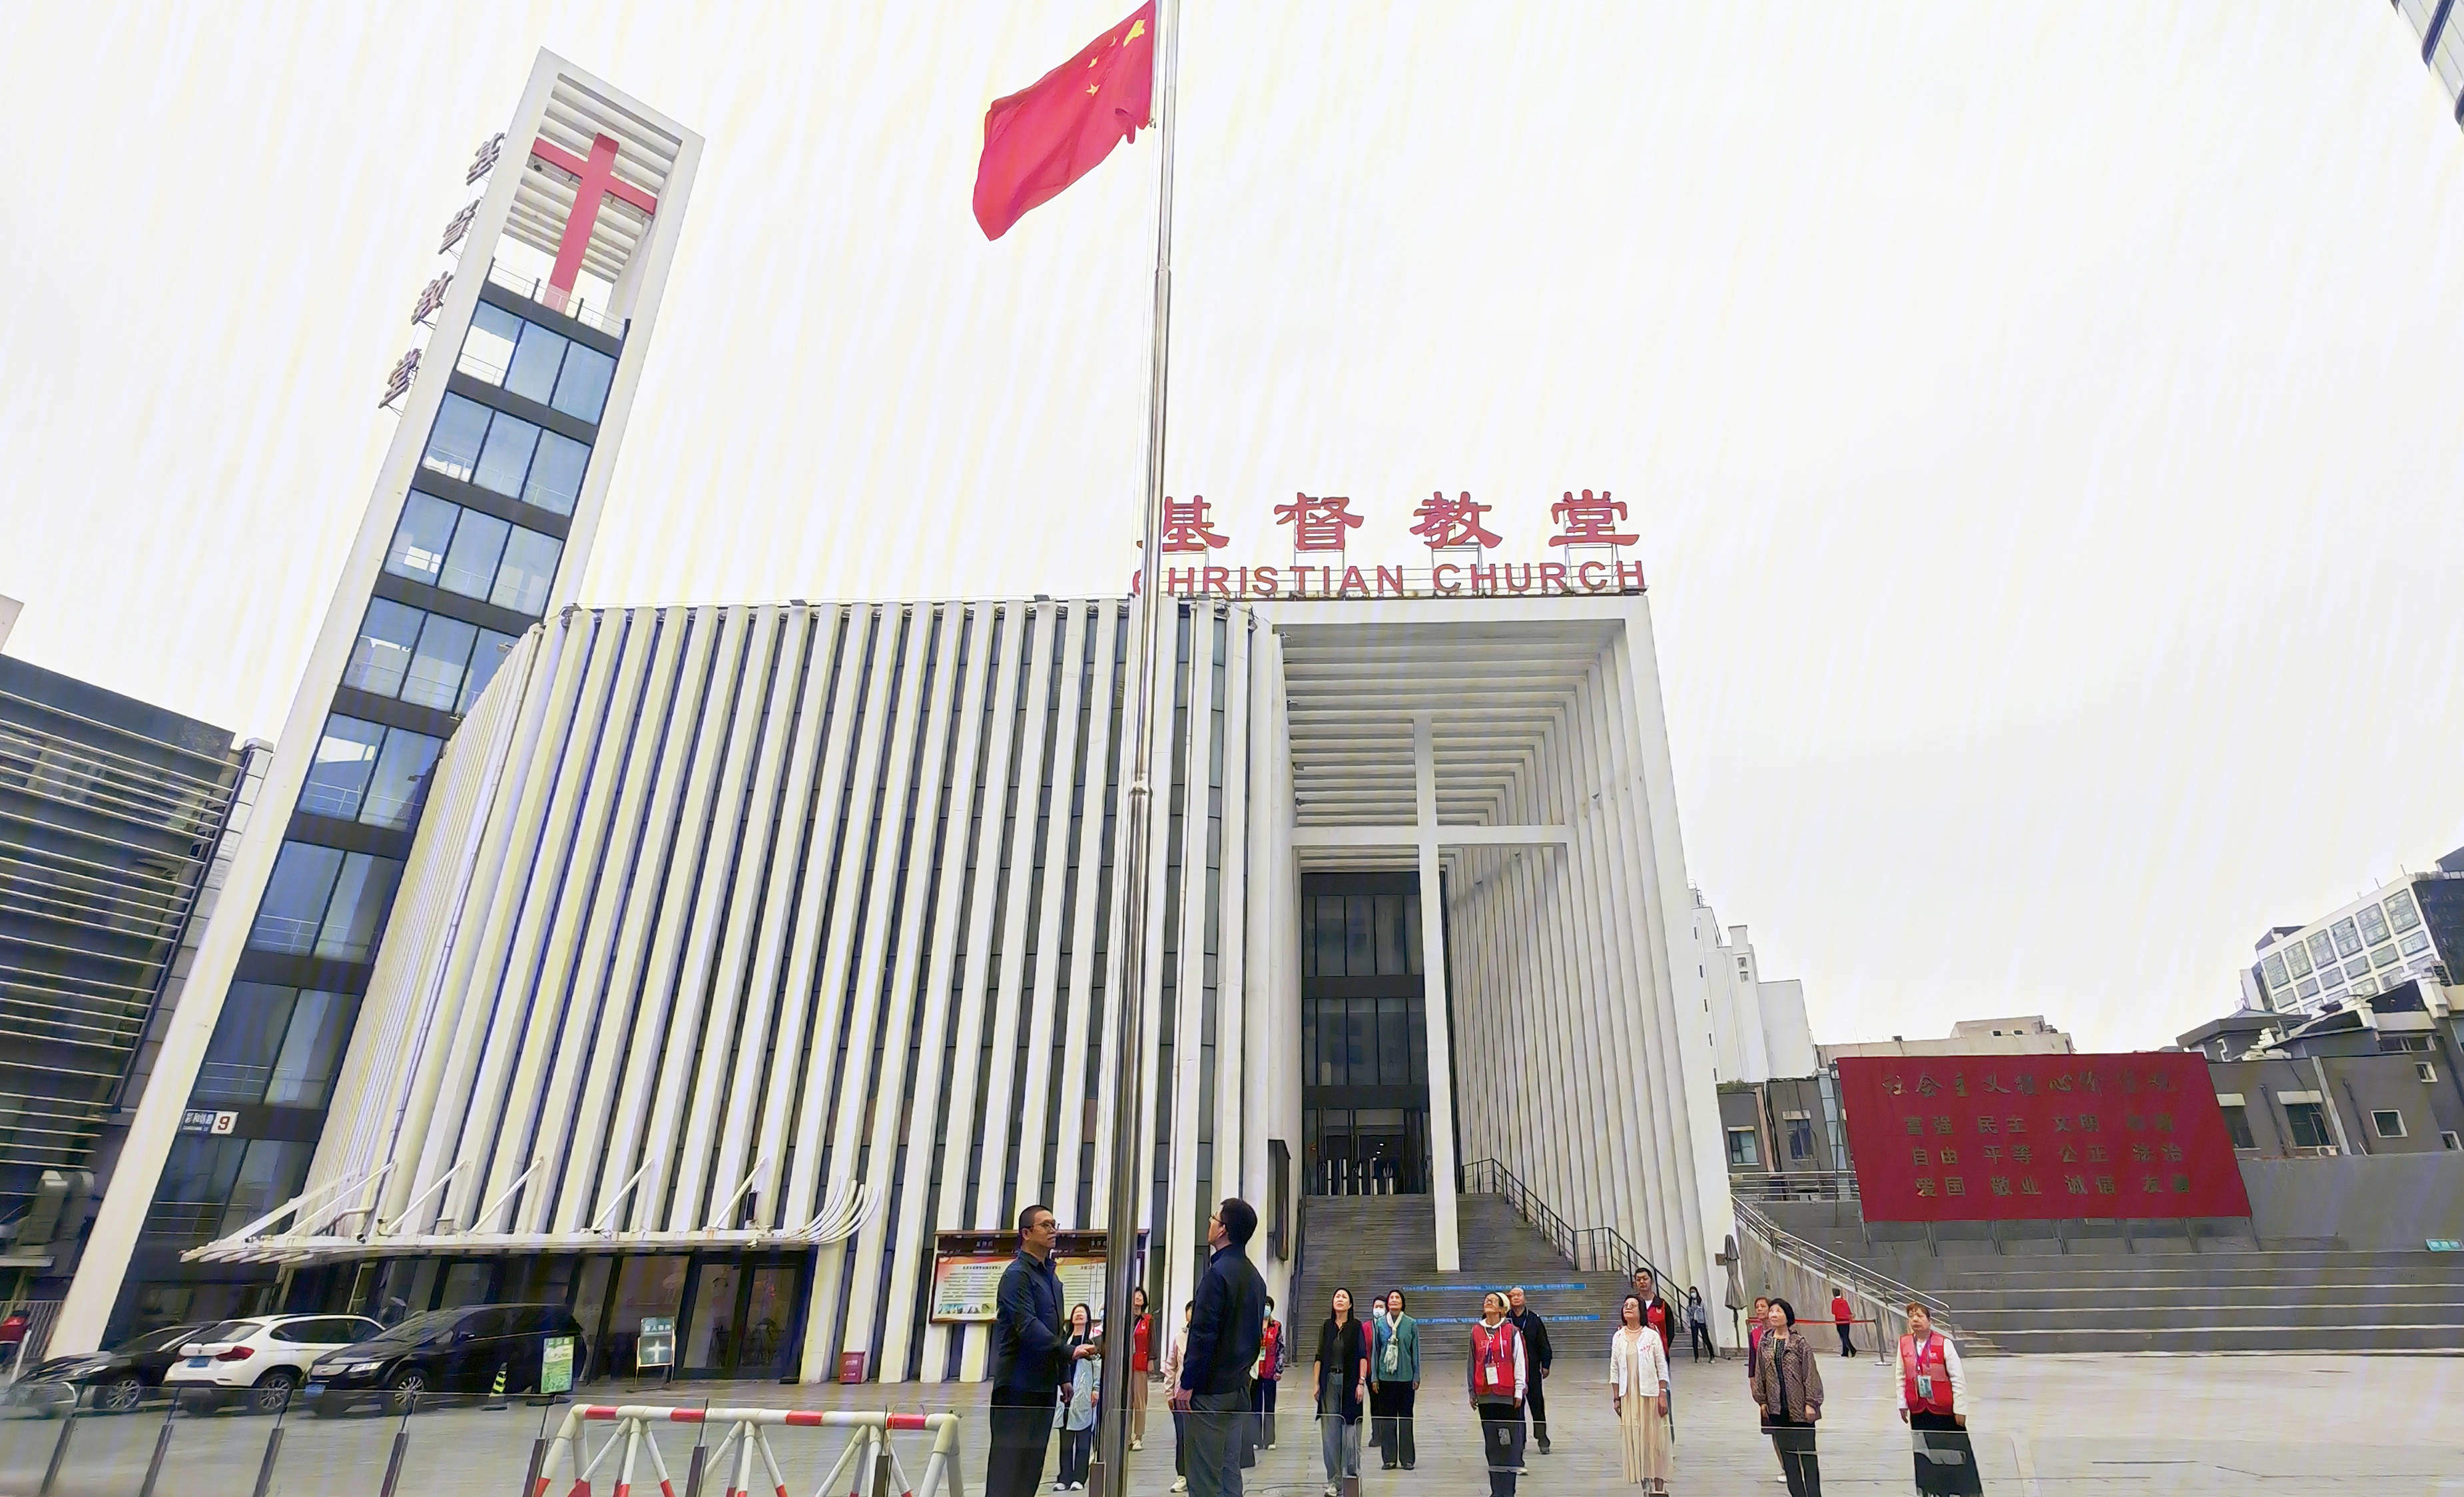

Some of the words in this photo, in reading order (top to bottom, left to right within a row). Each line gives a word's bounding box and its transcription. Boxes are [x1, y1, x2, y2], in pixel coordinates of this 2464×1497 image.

[1137, 489, 1640, 551] 基督教堂
[1432, 561, 1644, 591] CHURCH
[1882, 1071, 2170, 1097] 社会主义心价
[217, 1116, 230, 1130] 9
[1977, 1115, 2027, 1133] 民主
[1912, 1146, 1959, 1166] 自由
[1983, 1145, 2033, 1165] 平等
[2058, 1145, 2110, 1163] 公正
[1915, 1176, 1966, 1197] 爱国
